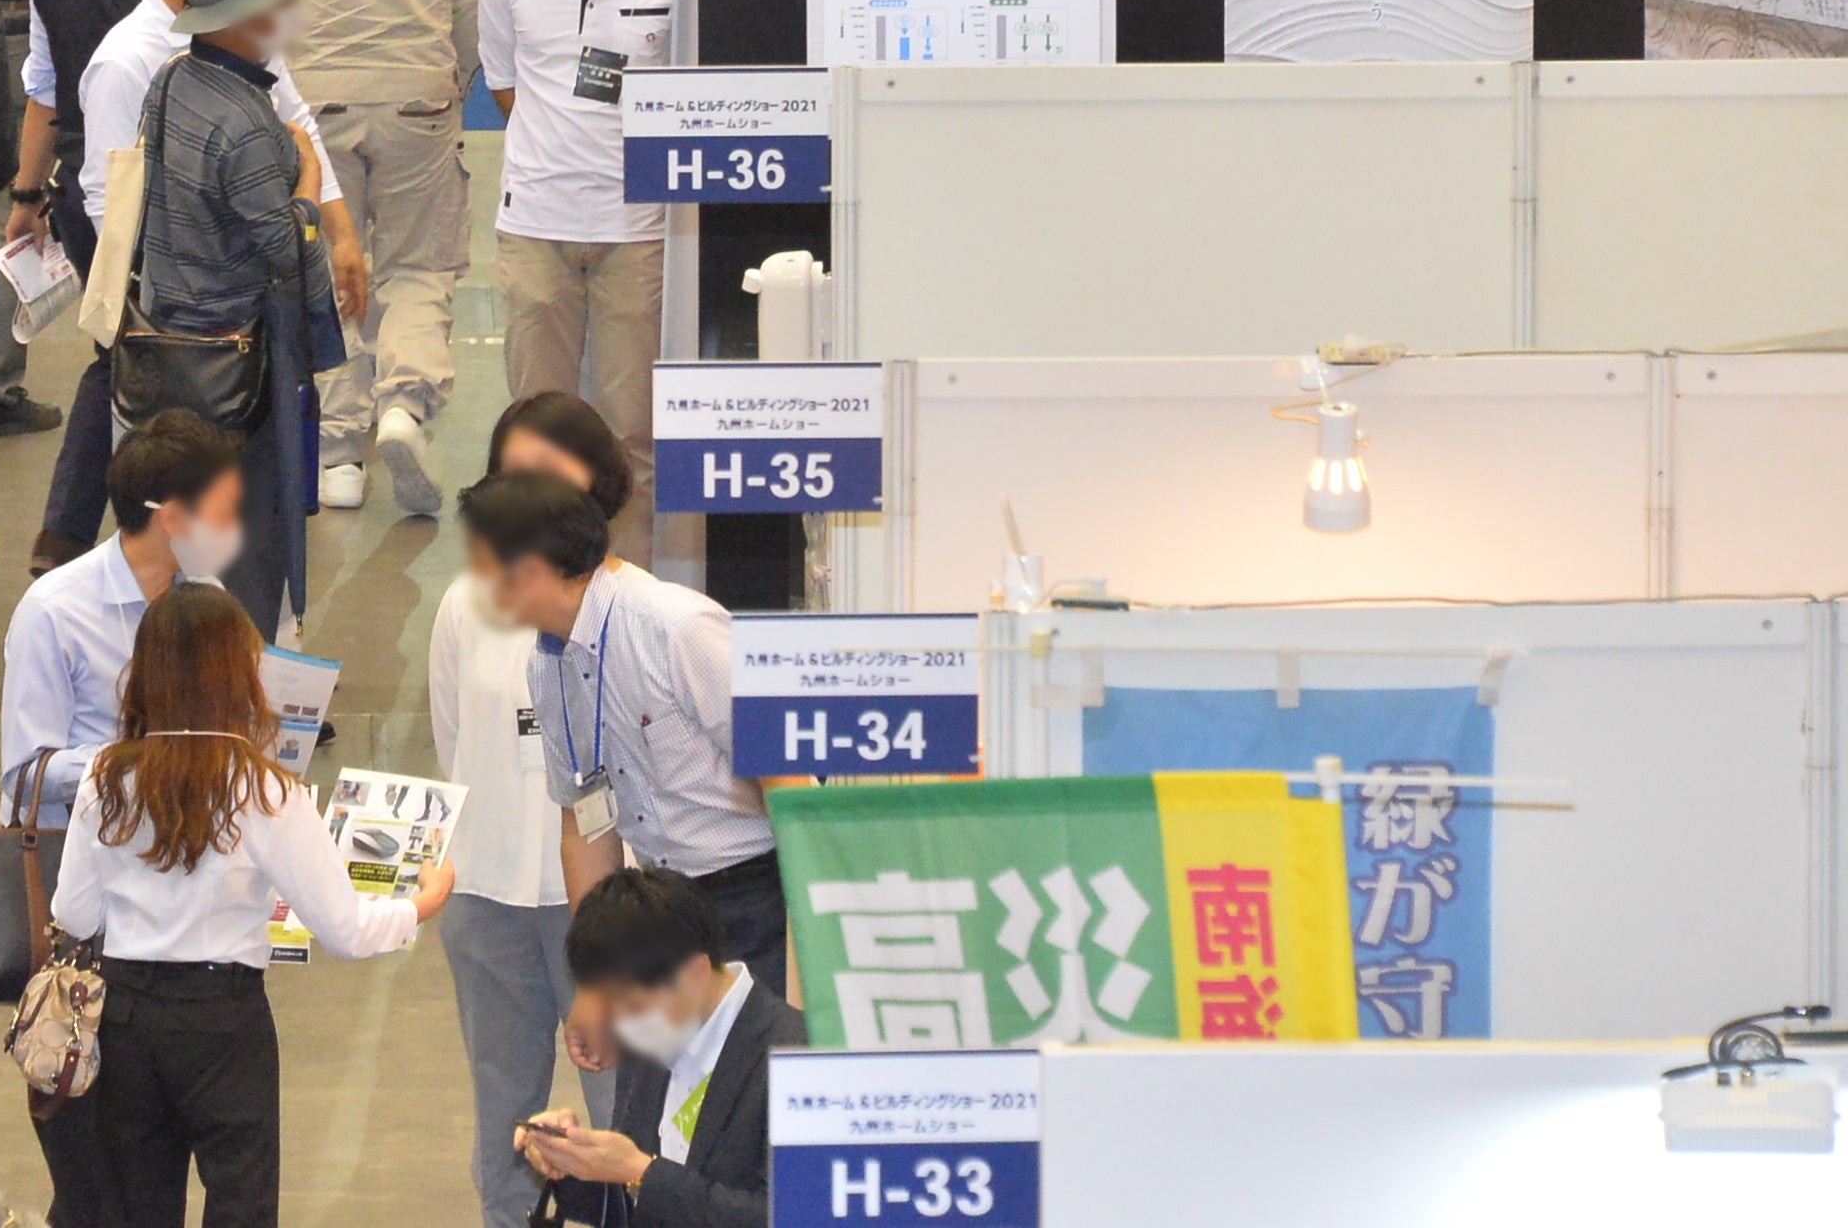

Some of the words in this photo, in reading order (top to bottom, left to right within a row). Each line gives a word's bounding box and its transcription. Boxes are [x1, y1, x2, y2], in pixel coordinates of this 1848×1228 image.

[667, 148, 787, 191] H-36
[703, 451, 834, 499] H-35
[784, 710, 927, 761] H-34
[831, 1157, 994, 1218] H-33
